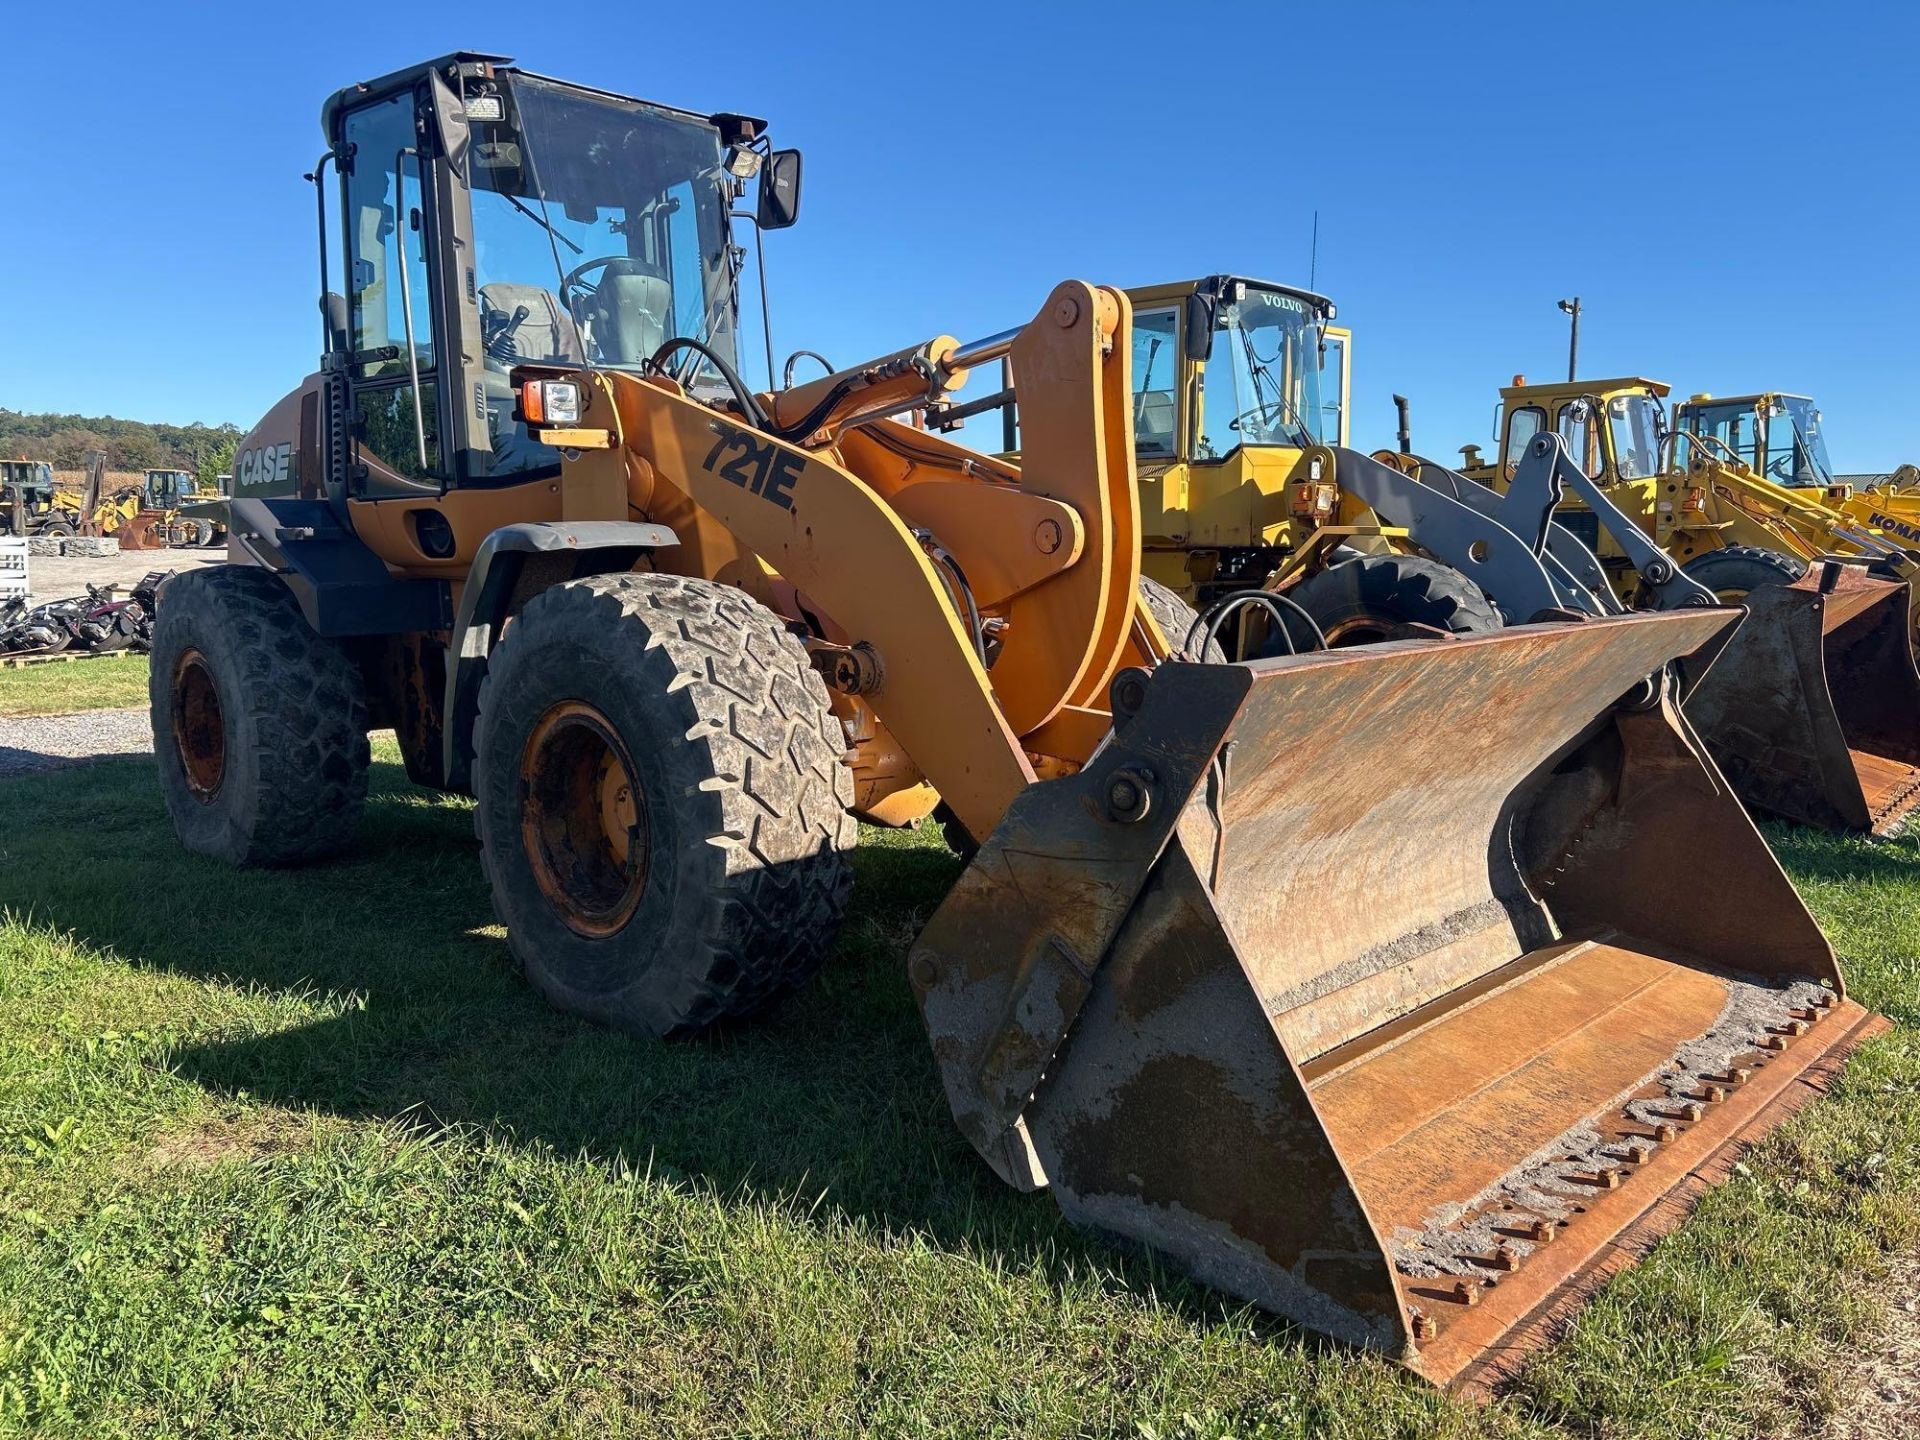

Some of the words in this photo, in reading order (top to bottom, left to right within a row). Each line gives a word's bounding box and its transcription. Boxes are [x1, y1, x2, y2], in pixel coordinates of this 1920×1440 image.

[1260, 293, 1303, 314] VOLVO
[240, 442, 291, 486] CASE
[702, 418, 807, 511] 721E
